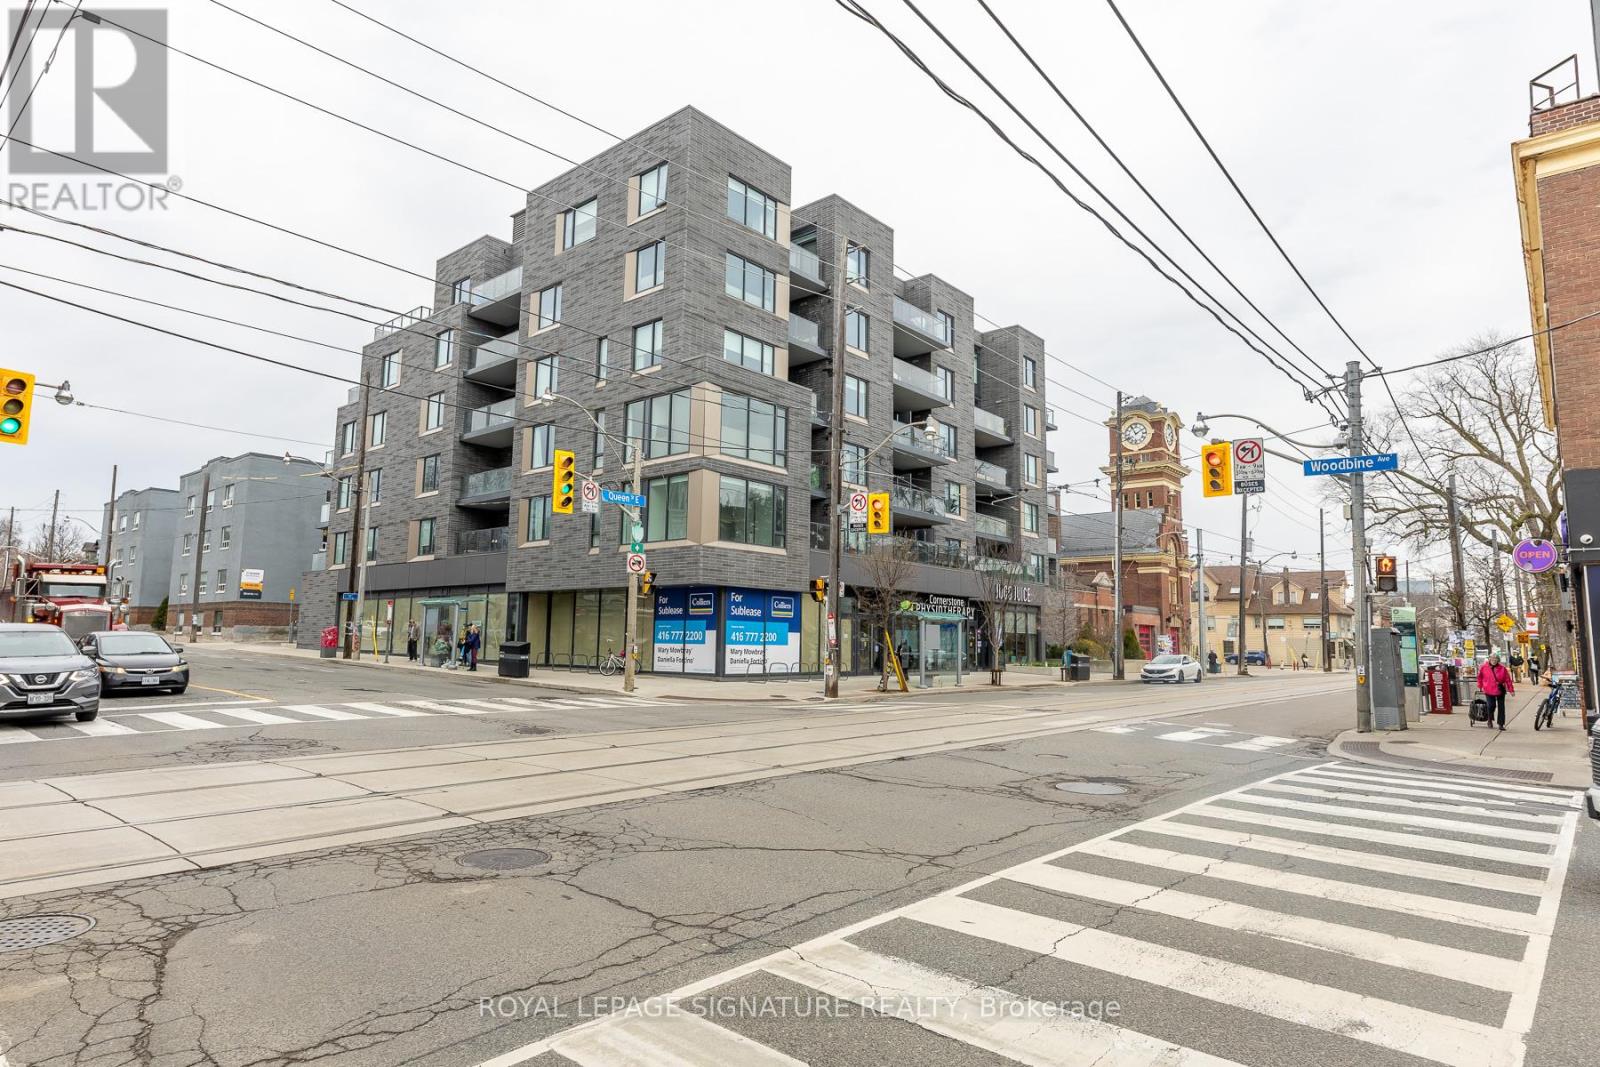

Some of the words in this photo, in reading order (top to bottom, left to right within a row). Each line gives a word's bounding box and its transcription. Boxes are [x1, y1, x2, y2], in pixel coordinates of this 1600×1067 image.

[1311, 458, 1374, 472] Woodbine
[608, 492, 630, 503] Queen
[1520, 551, 1550, 559] OPEN
[658, 596, 668, 604] For
[691, 598, 711, 606] Colliers
[730, 592, 743, 603] For
[929, 594, 965, 607] Cornerstone
[658, 606, 683, 615] Sublease
[773, 600, 791, 610] Colliers
[916, 602, 976, 617] PHYSIOTHERAPY
[730, 605, 762, 617] Sublease
[657, 630, 670, 640] 416
[671, 631, 684, 641] 777
[685, 631, 703, 641] 2200
[731, 631, 744, 642] 416
[745, 632, 758, 642] 777
[759, 632, 777, 642] 2200
[730, 648, 743, 656] Mary
[750, 657, 768, 665] Fortio
